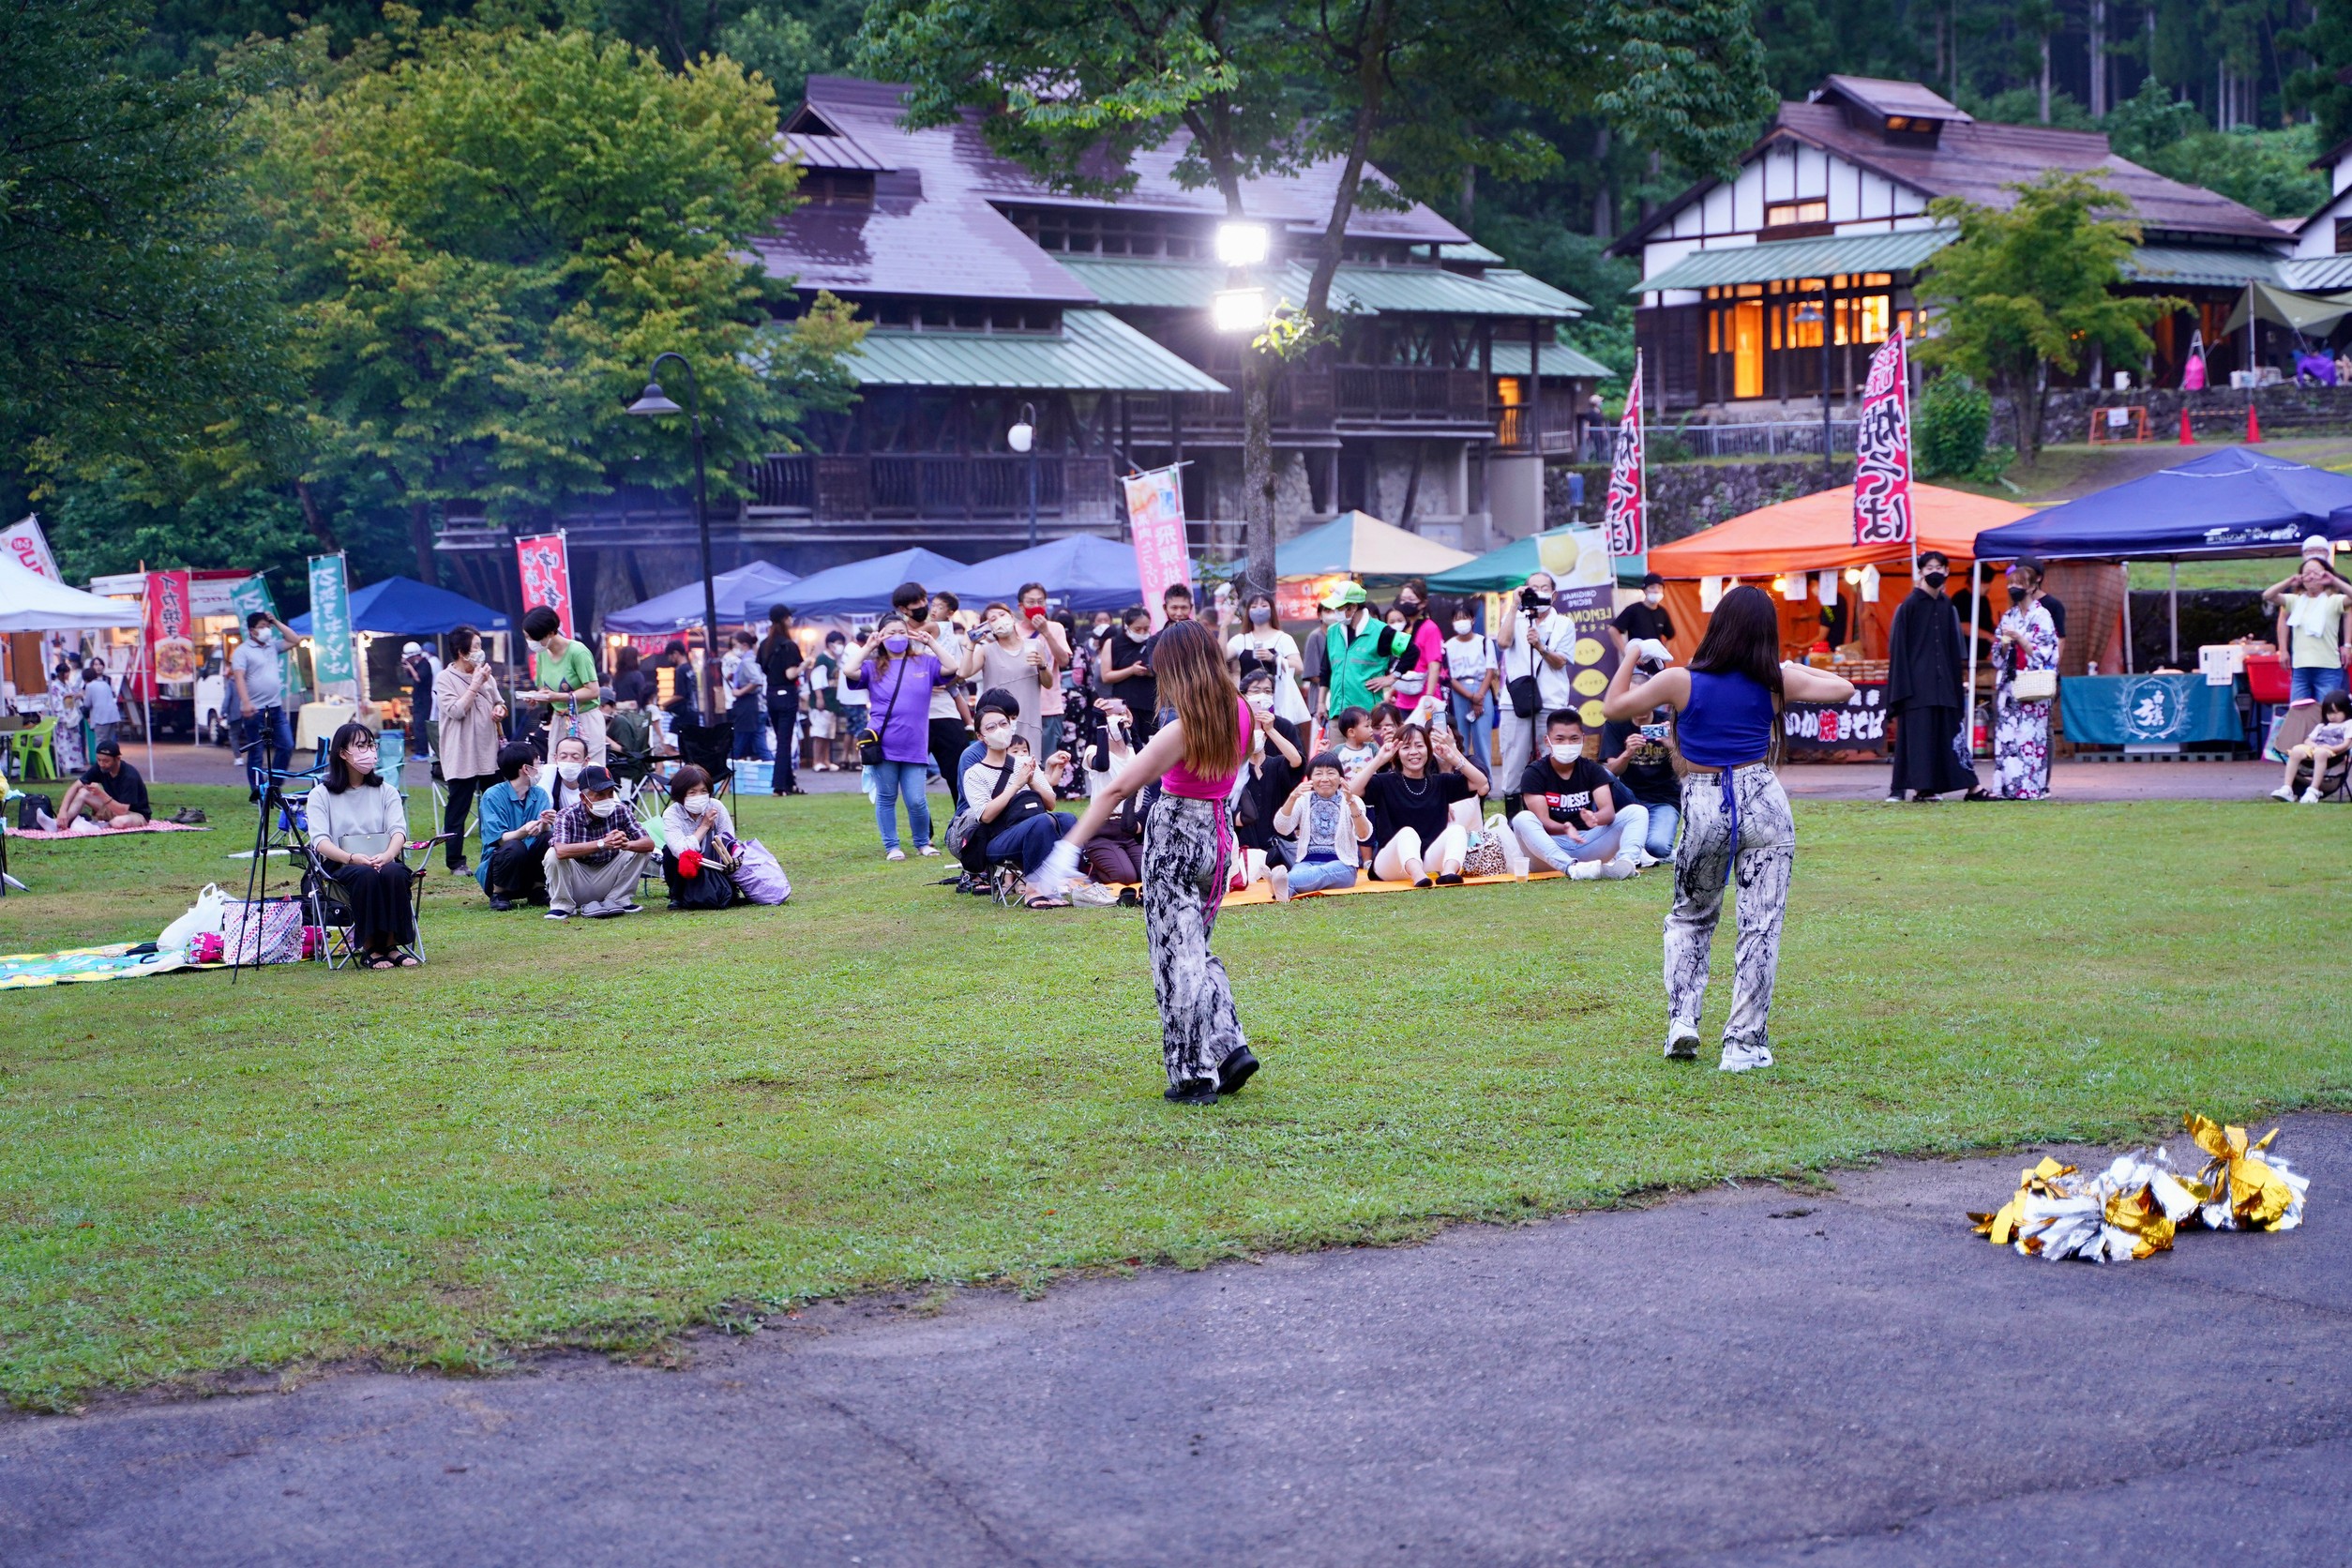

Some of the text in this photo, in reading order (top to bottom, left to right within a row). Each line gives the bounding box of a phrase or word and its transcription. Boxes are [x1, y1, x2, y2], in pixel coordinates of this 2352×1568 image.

[1784, 708, 1887, 742] いか焼きそば
[1560, 791, 1591, 807] DIESEL
